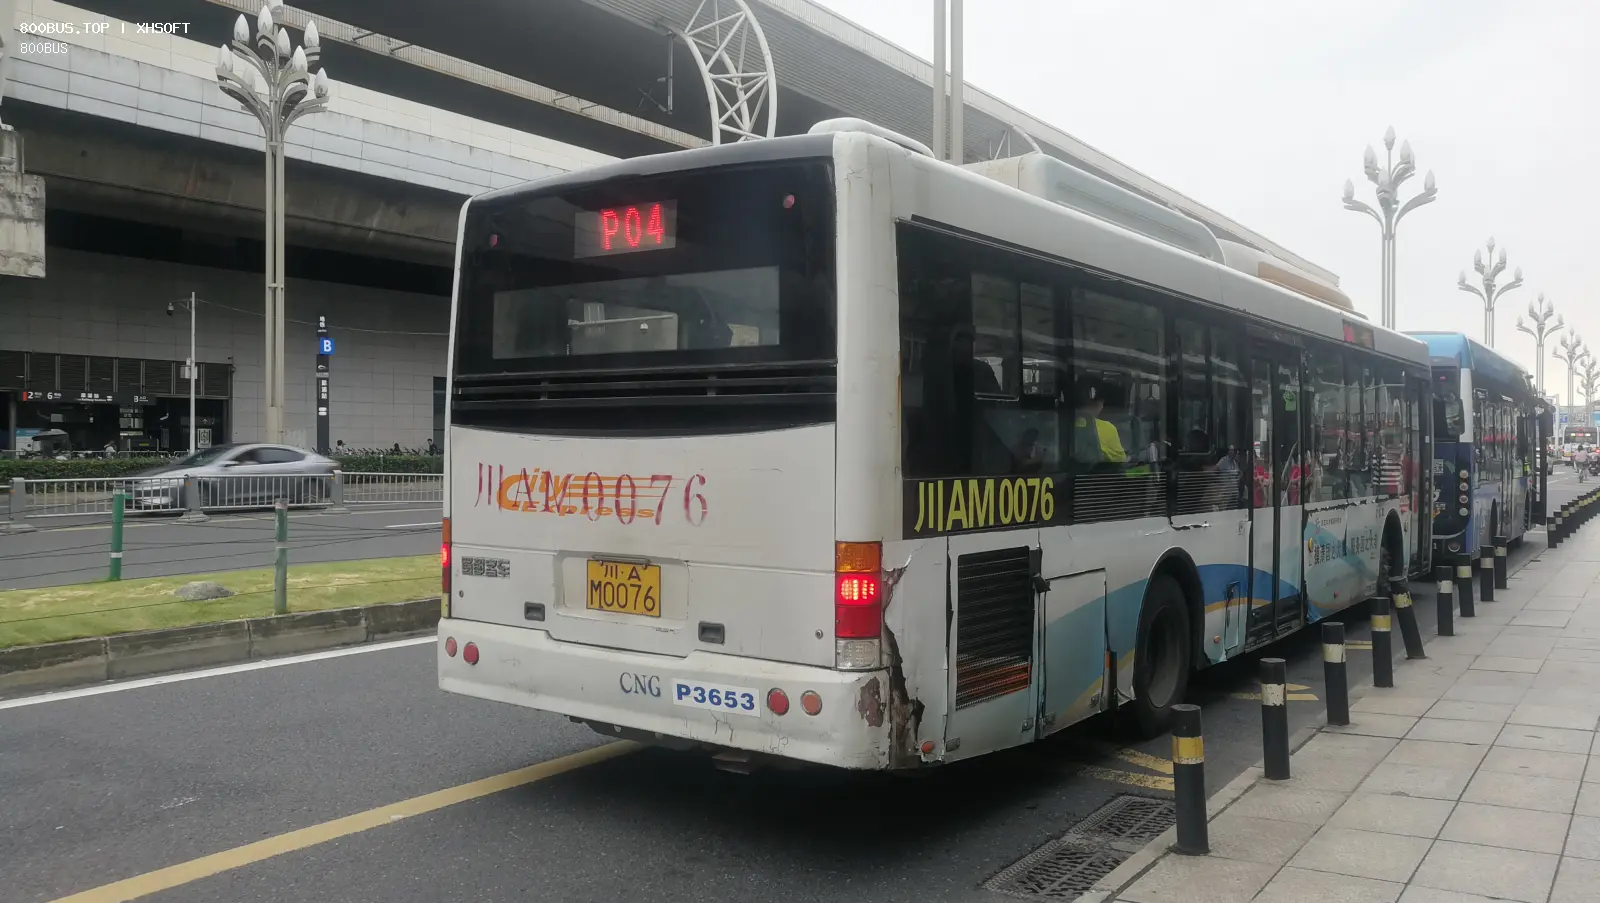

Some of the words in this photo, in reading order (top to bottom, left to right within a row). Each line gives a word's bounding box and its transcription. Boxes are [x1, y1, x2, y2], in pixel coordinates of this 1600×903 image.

[602, 202, 665, 251] P04
[323, 340, 332, 352] B
[27, 391, 34, 399] 2
[47, 392, 53, 400] 6
[521, 502, 655, 518] Express
[590, 581, 656, 612] M0076
[620, 671, 661, 698] CNG
[677, 683, 755, 711] P3653
